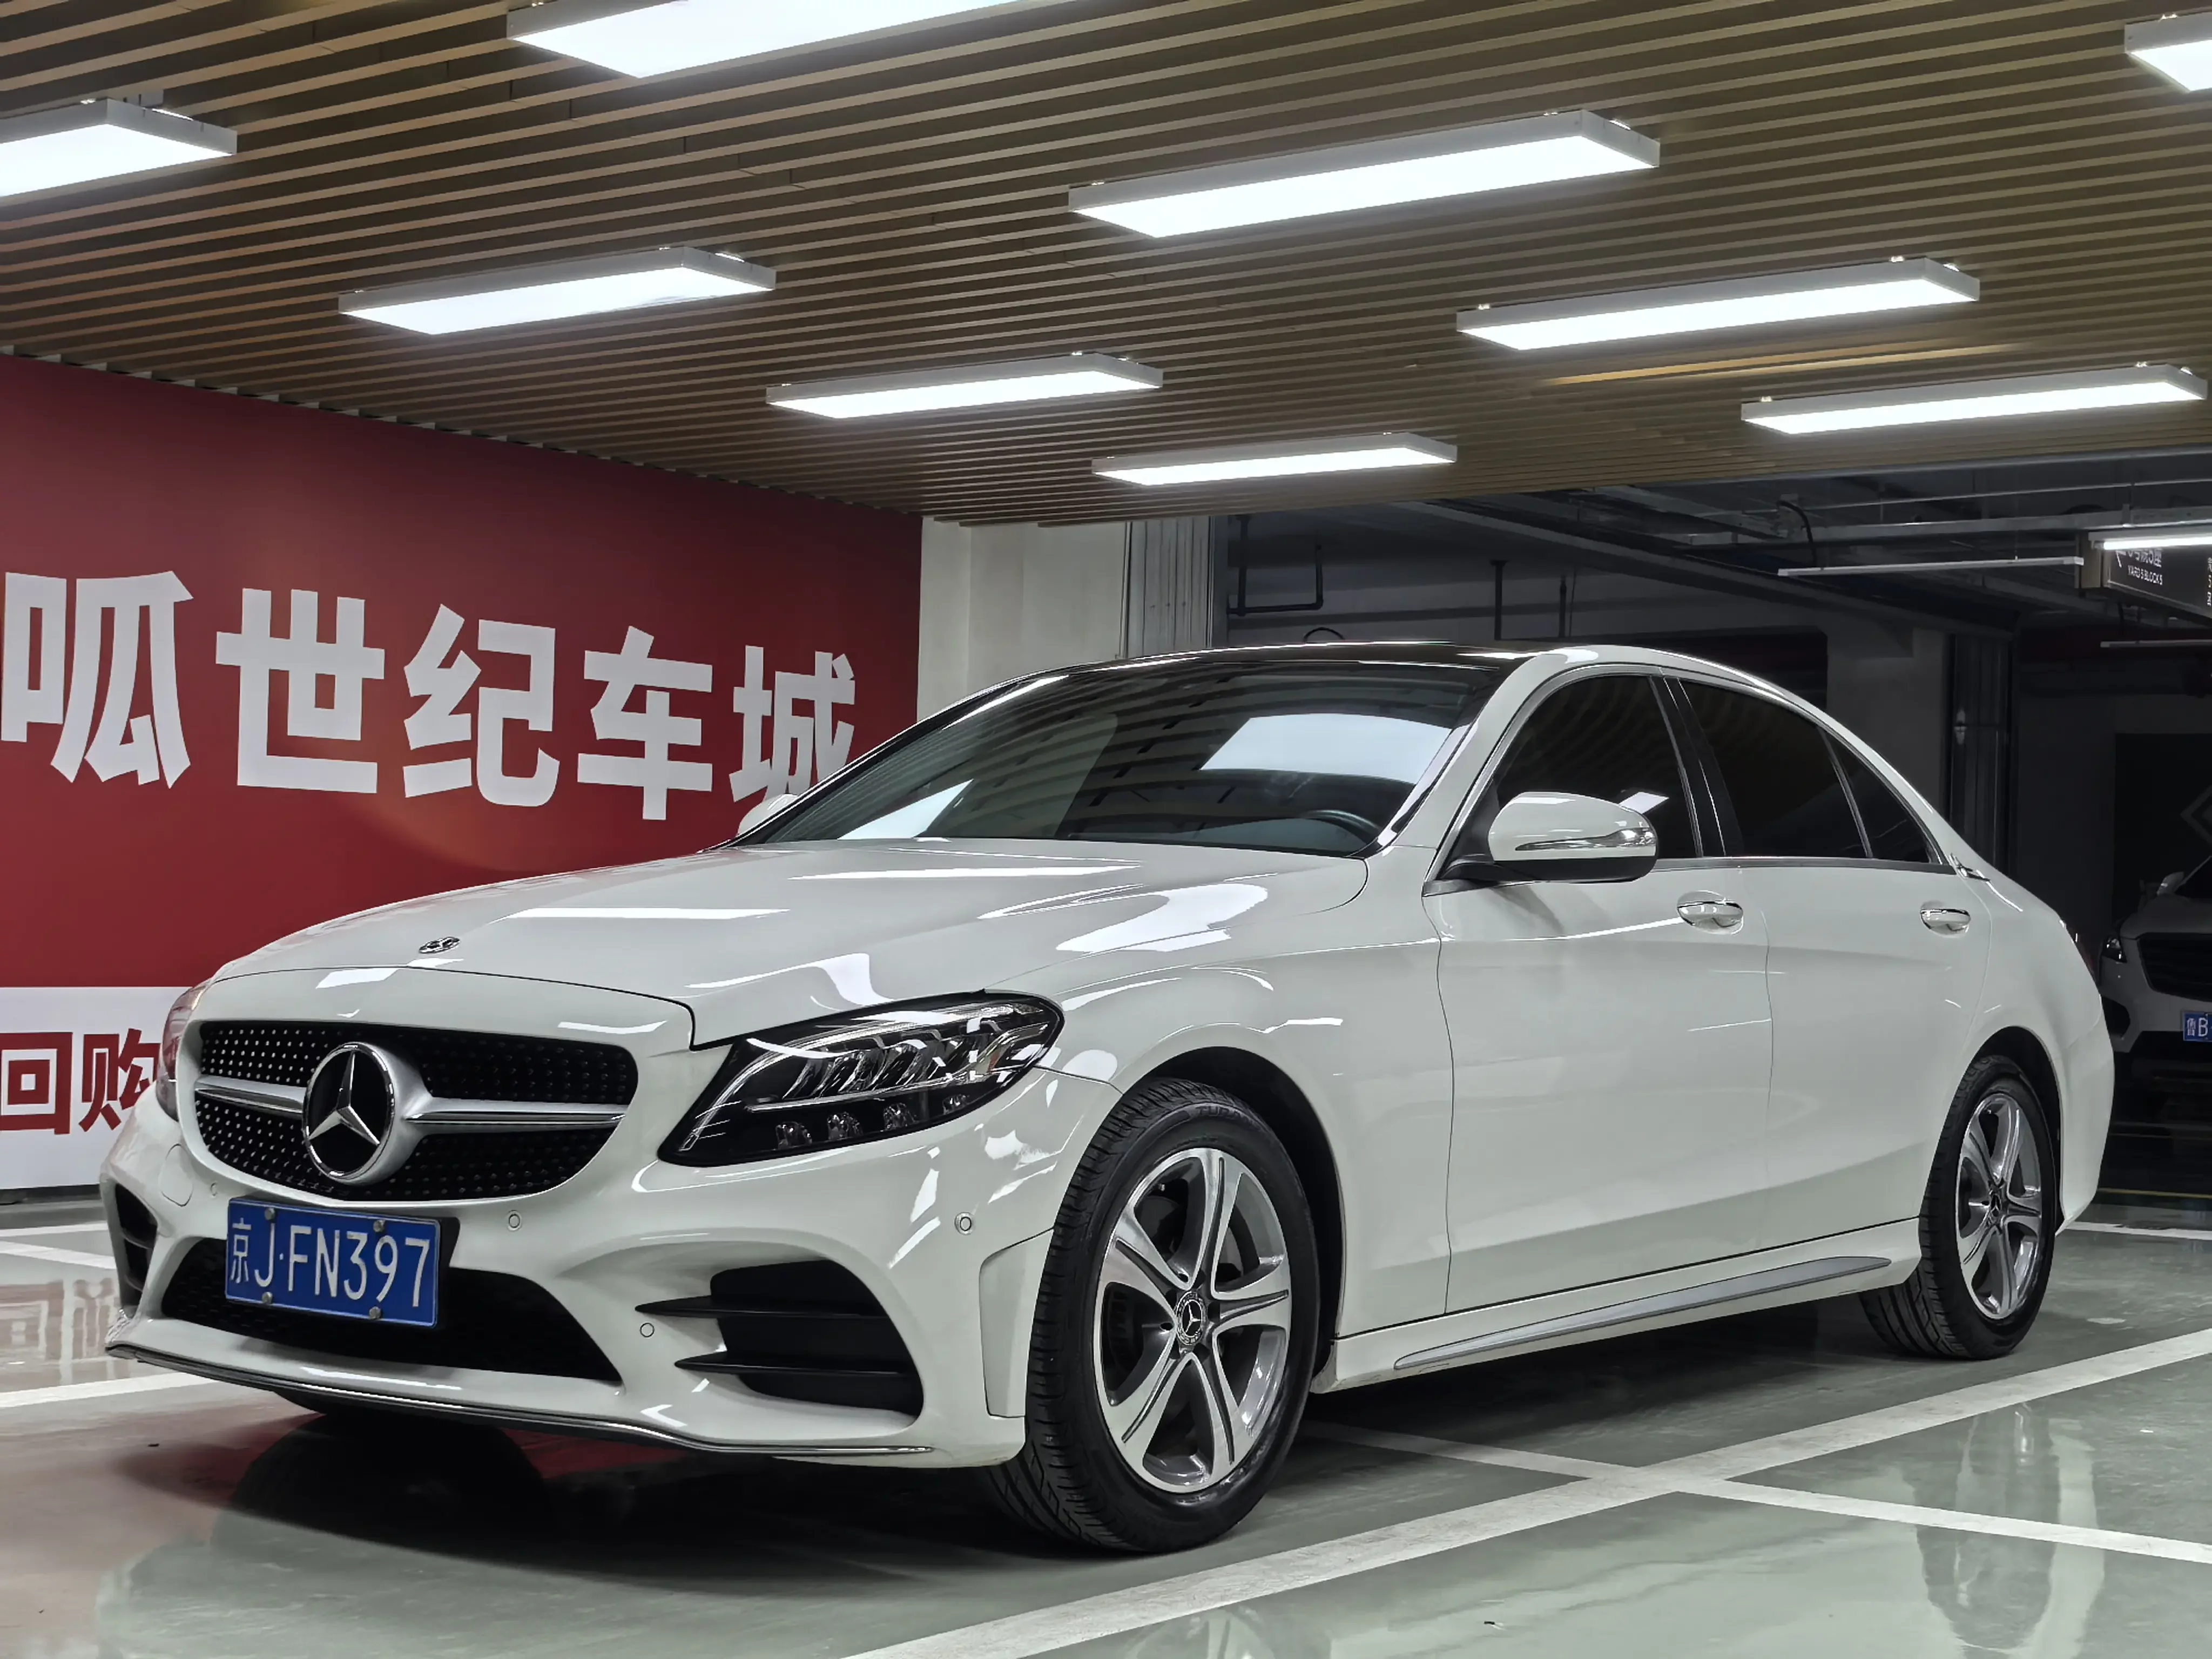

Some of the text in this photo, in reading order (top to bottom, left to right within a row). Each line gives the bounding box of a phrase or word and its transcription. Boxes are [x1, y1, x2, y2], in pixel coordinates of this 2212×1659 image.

[1, 570, 855, 820] 呱世纪车城
